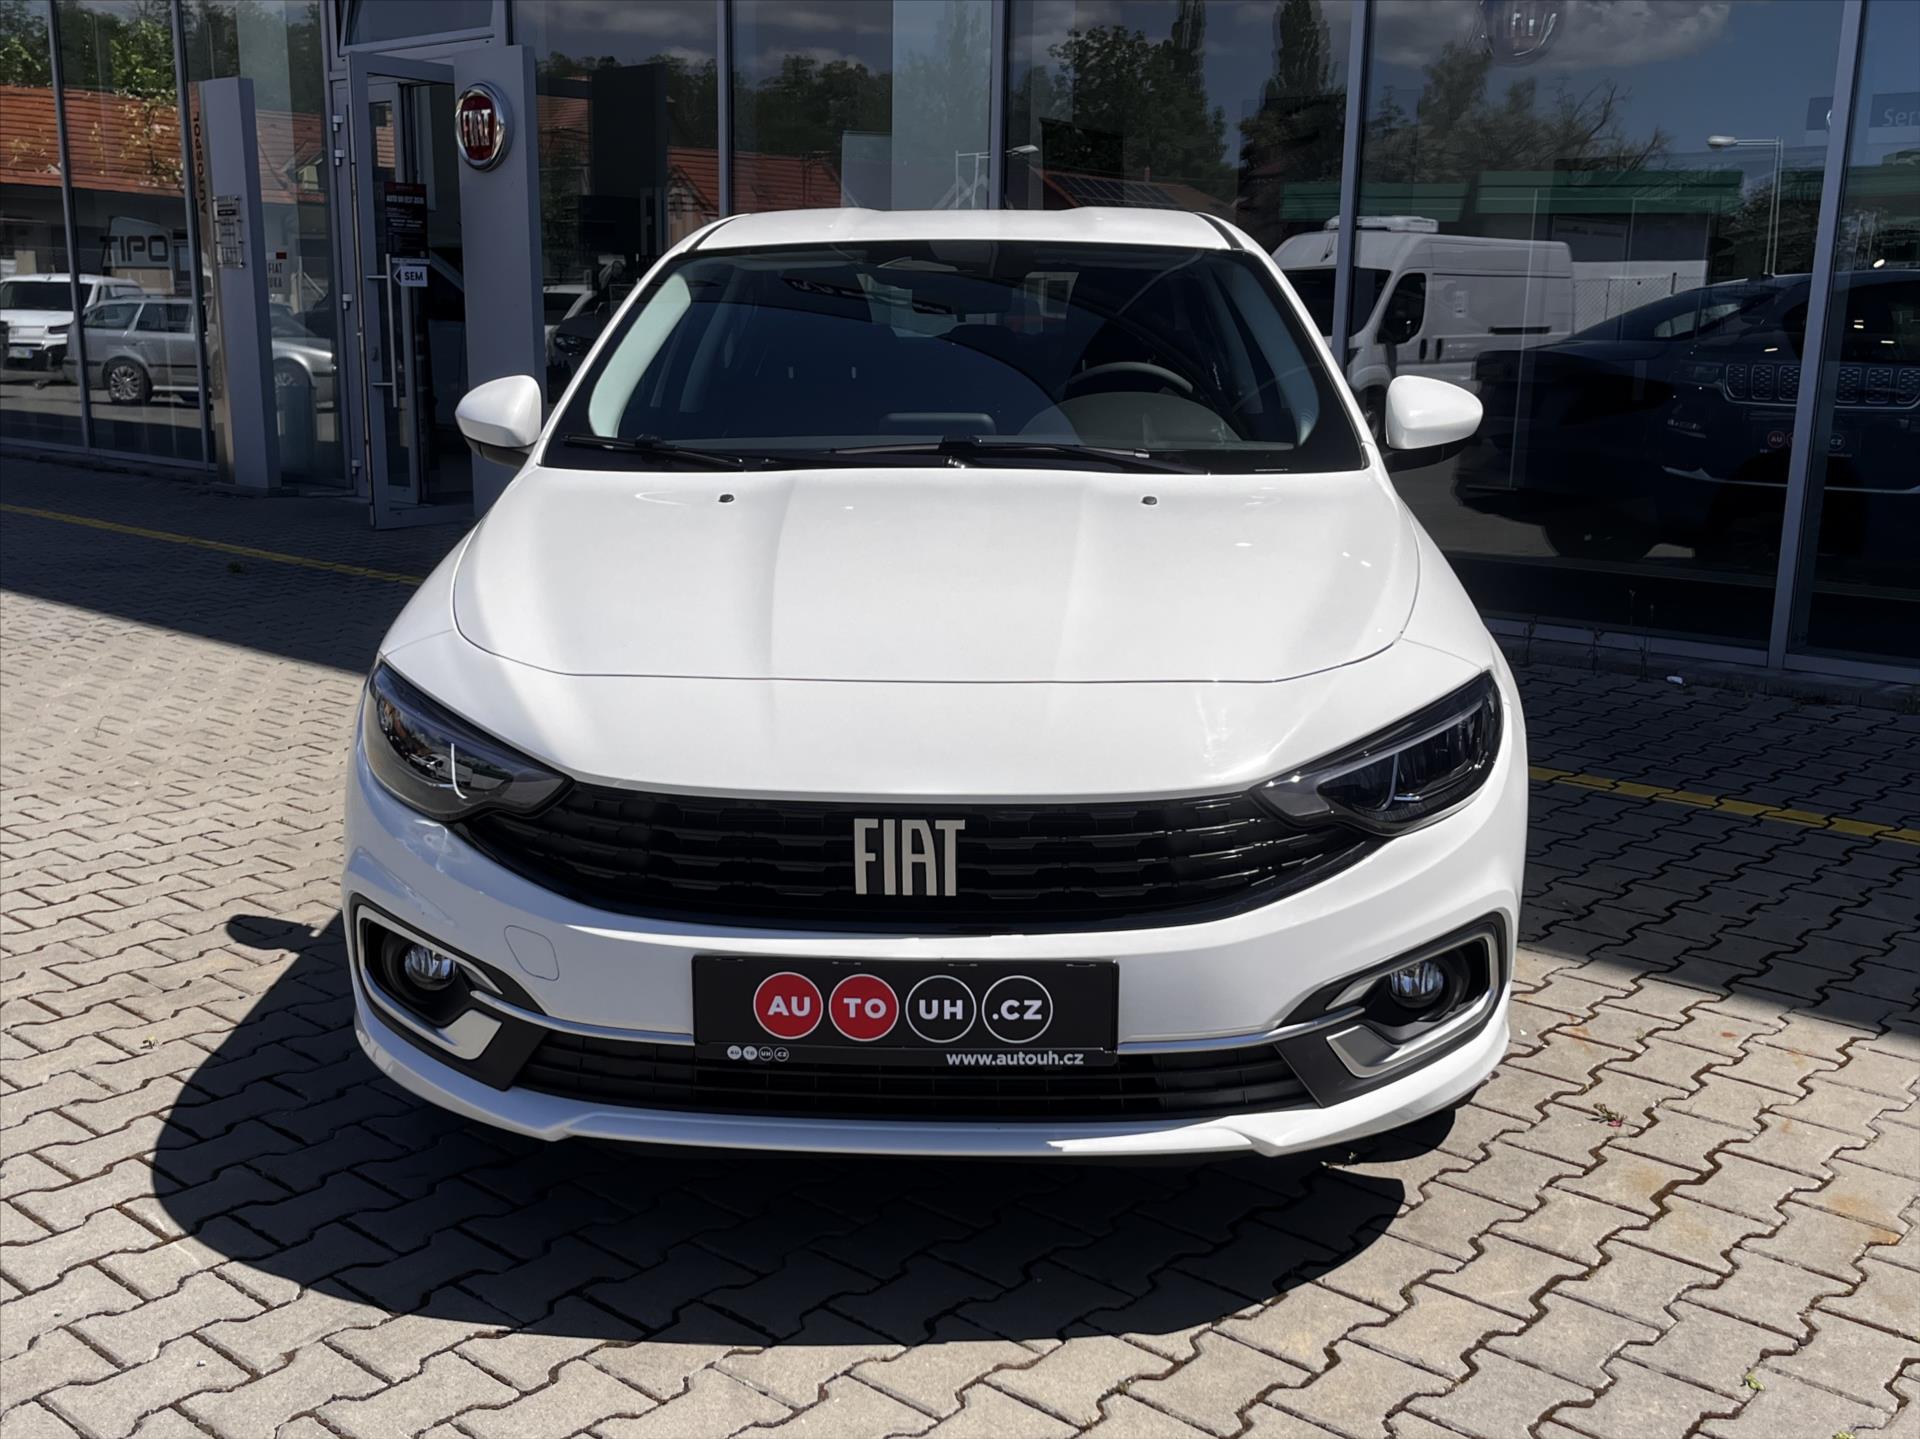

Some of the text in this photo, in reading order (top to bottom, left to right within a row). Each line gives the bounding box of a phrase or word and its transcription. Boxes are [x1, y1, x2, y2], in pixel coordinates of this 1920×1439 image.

[193, 111, 208, 214] AUTOSPOL
[99, 235, 169, 262] TIPO
[404, 271, 424, 281] SEM
[854, 818, 966, 896] FIAT
[767, 995, 1043, 1021] AU TO UH .CZ
[946, 1051, 1084, 1066] www.autouh.cz
